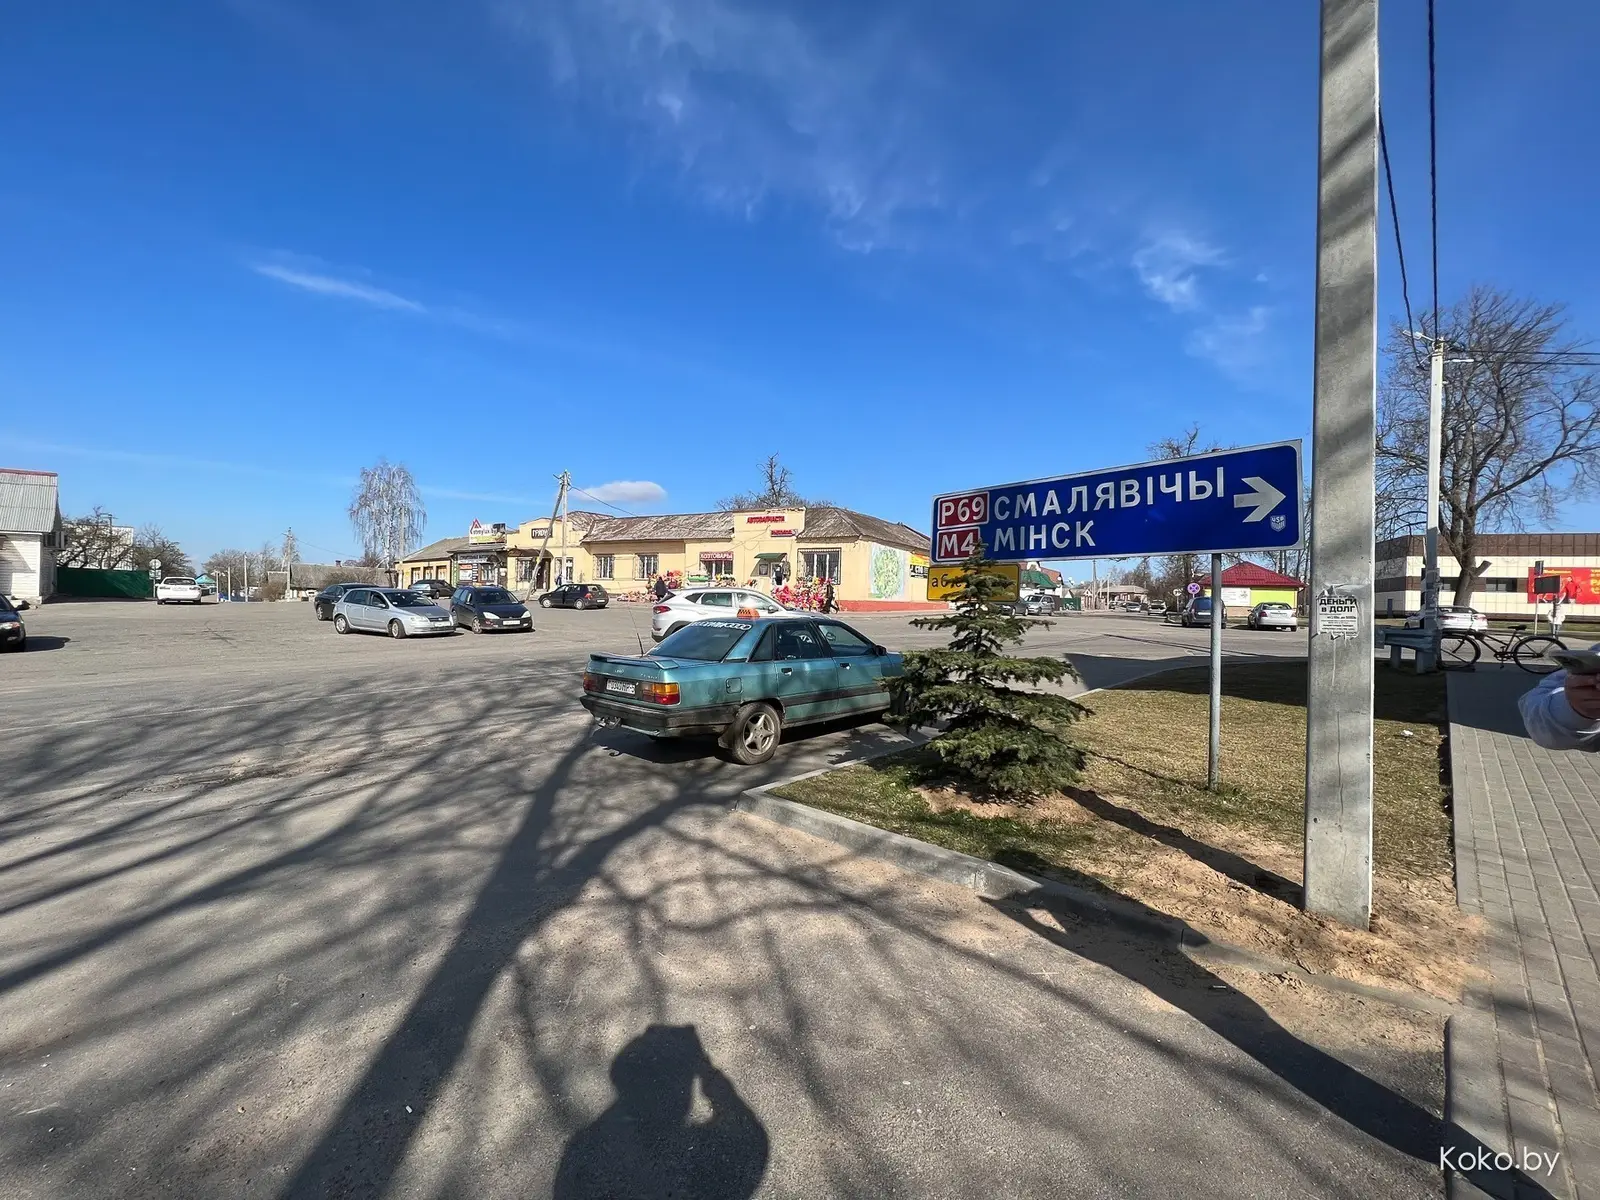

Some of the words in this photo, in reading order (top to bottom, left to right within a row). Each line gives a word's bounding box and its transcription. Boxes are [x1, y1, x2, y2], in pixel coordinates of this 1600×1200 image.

[941, 496, 985, 525] Р69
[994, 466, 1224, 521] СМАЛЯВІЧЫ
[940, 532, 976, 557] М4
[994, 520, 1096, 552] МІНСК
